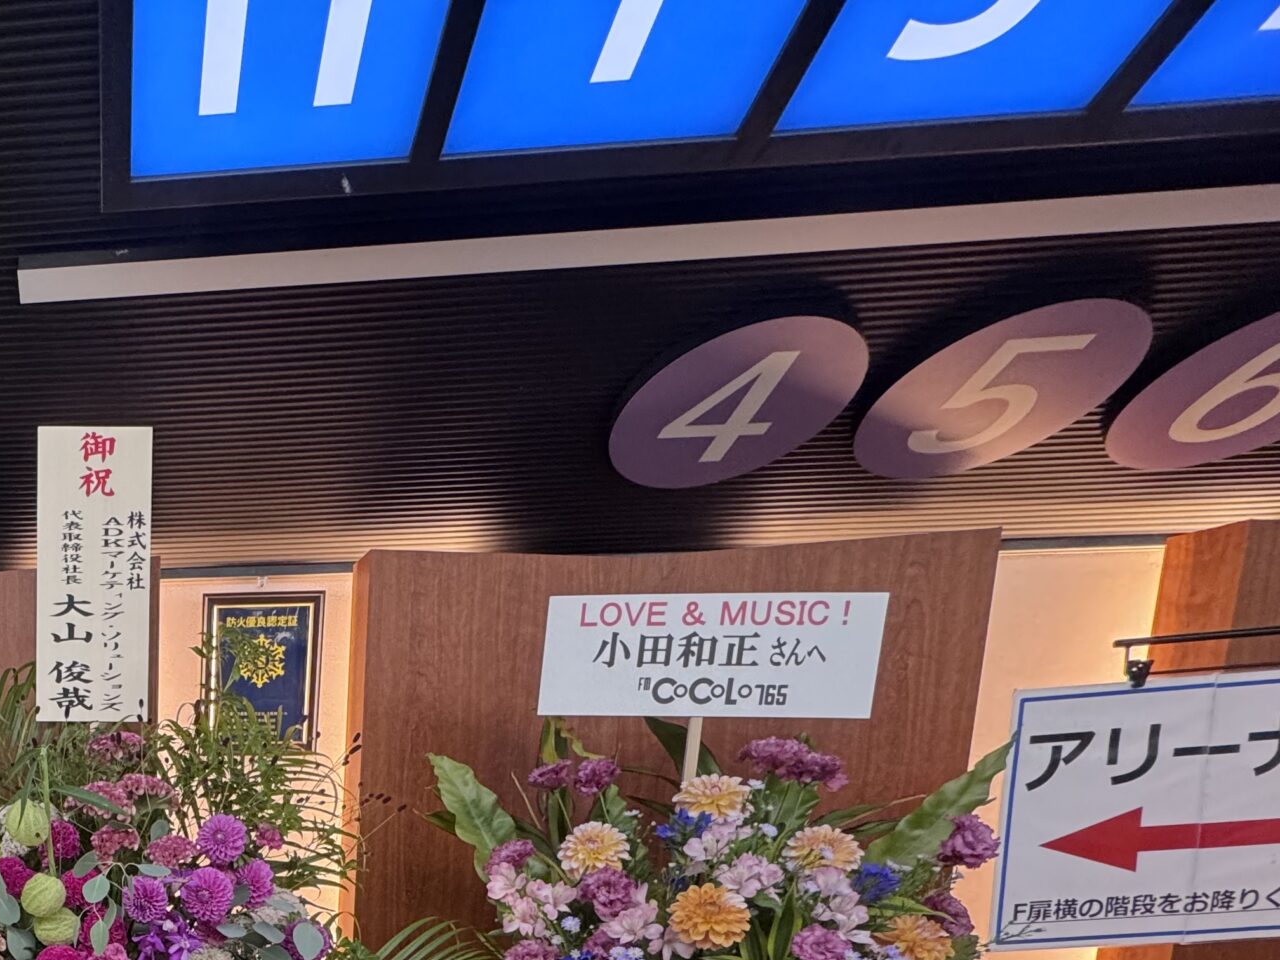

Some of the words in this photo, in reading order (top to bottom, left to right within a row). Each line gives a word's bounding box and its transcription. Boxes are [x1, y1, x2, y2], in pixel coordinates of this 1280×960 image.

[656, 350, 801, 463] 4
[907, 334, 1097, 454] 5
[1168, 343, 1280, 443] 6
[79, 432, 117, 497] 御祝
[126, 510, 147, 590] 株式会社
[579, 601, 668, 627] LOVE
[681, 601, 707, 626] &
